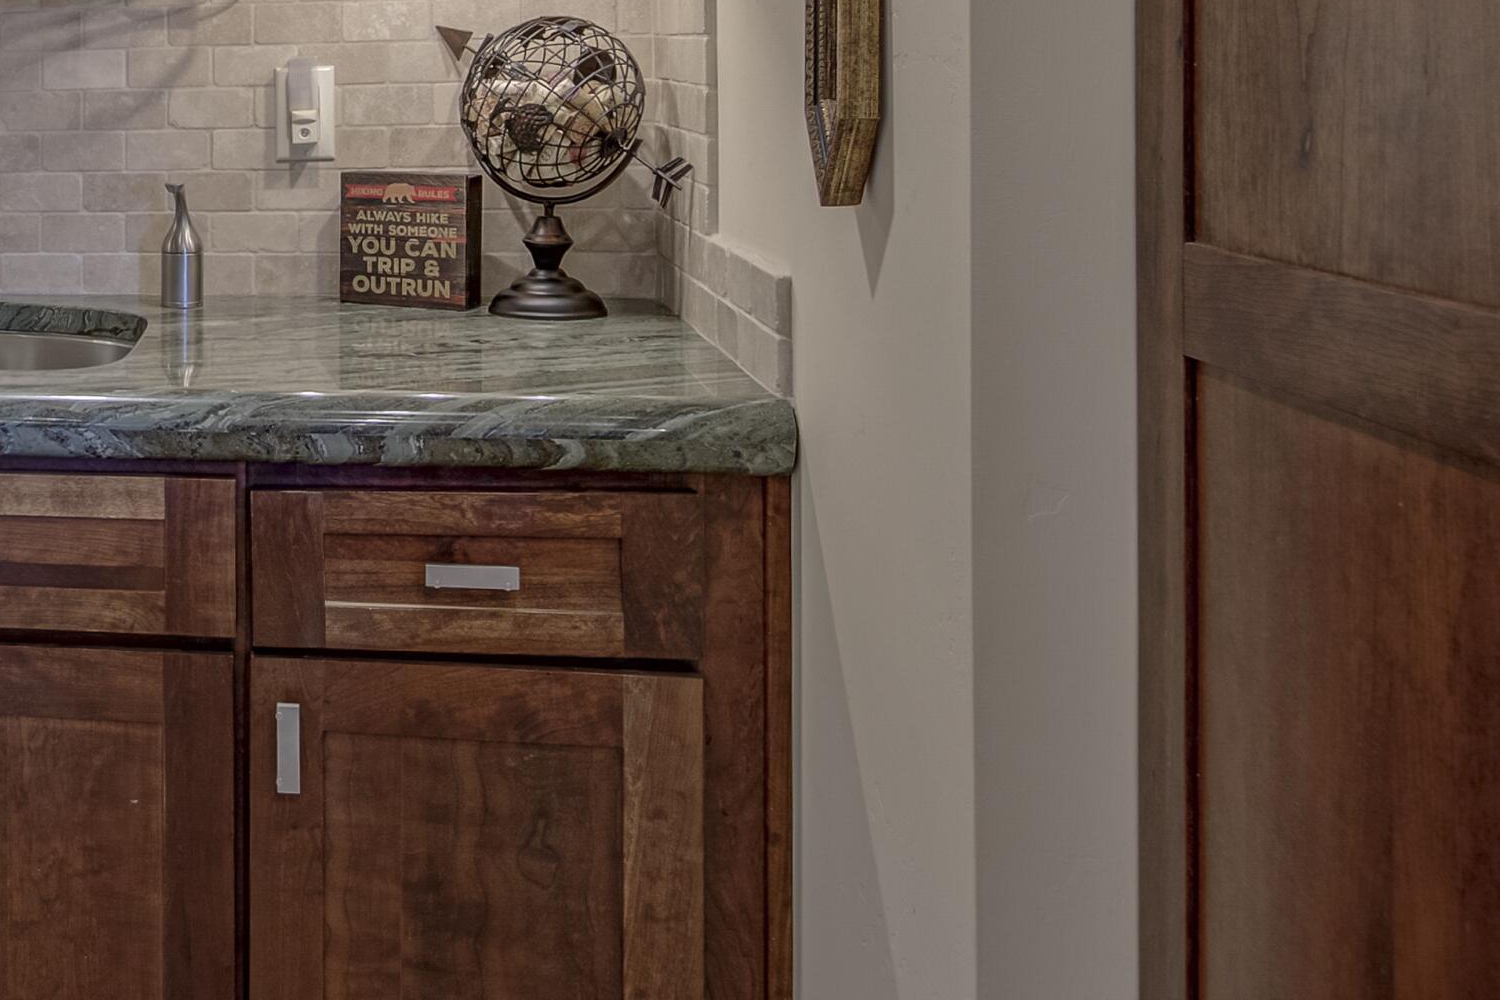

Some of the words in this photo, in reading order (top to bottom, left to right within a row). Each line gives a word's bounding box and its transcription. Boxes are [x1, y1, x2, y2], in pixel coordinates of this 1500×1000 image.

[418, 189, 450, 199] RULES
[356, 210, 411, 222] ALWAYS
[416, 212, 449, 224] HIKE
[348, 223, 383, 235] WITH
[388, 224, 457, 239] SOMEONE
[348, 236, 396, 255] YOU
[405, 239, 457, 259] CAN
[362, 256, 415, 276] TRIP
[424, 260, 440, 277] &
[352, 275, 450, 299] OUTRUN
